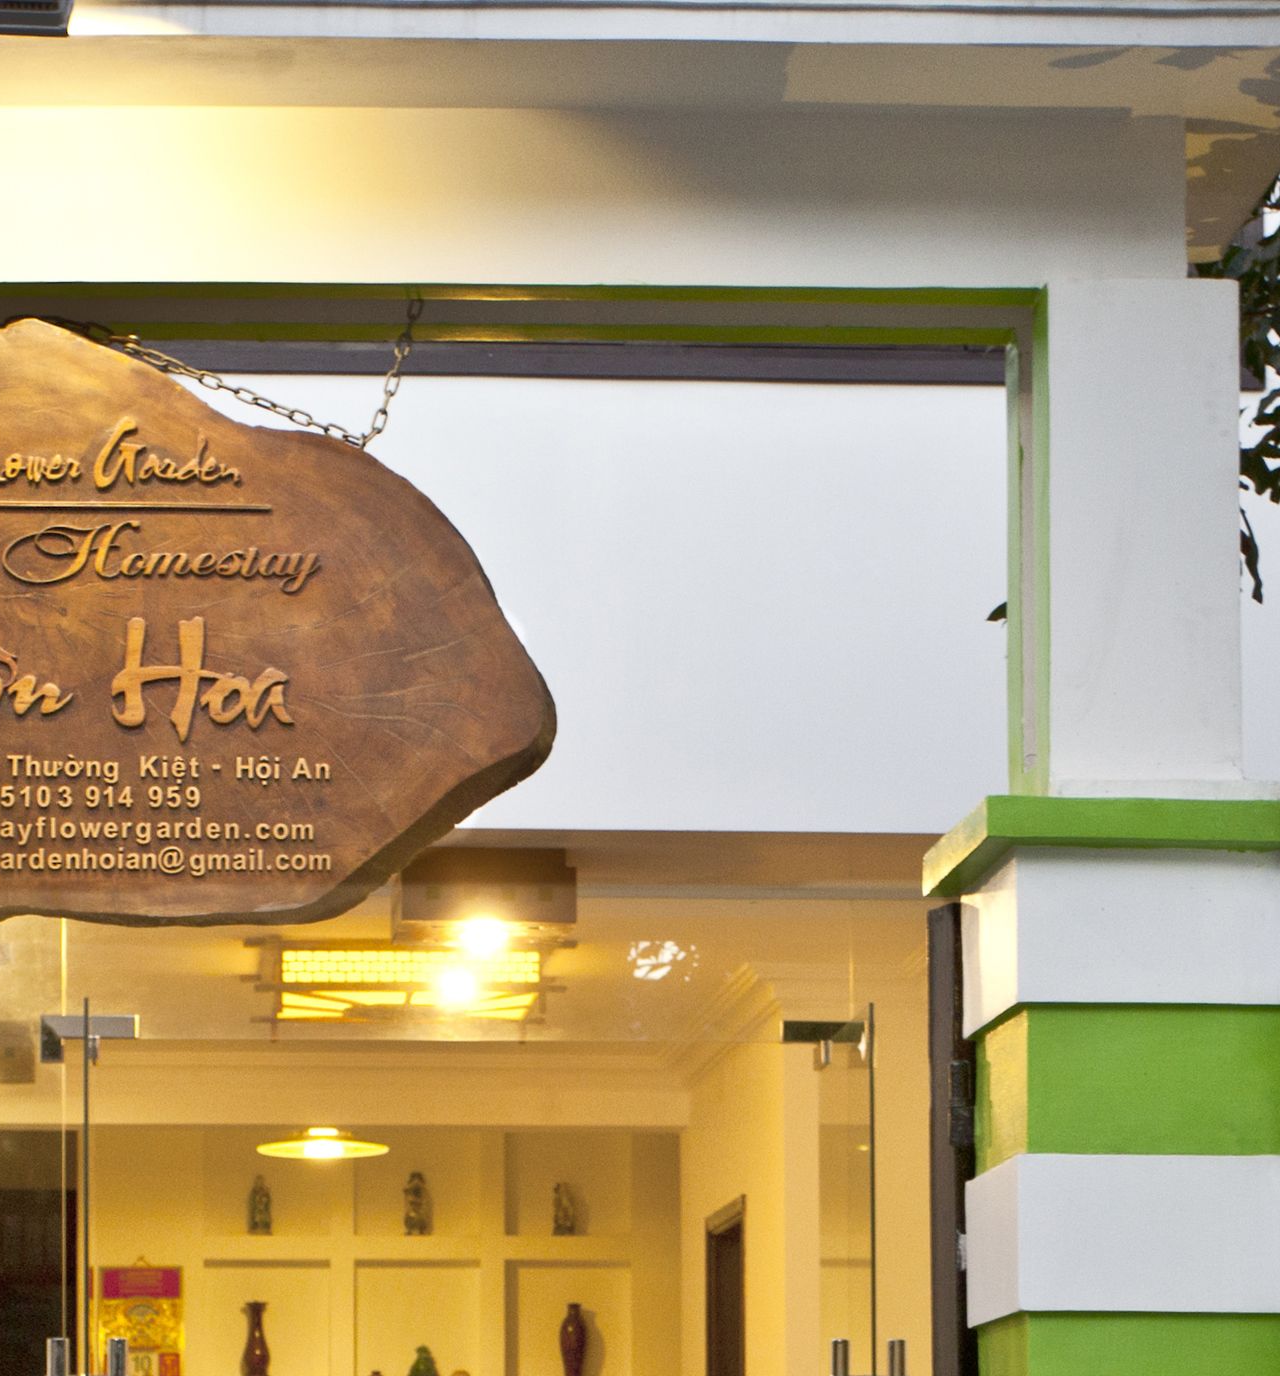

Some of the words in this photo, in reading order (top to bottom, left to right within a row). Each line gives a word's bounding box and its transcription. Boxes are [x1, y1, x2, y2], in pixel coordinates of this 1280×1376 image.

[93, 416, 242, 489] Garden
[2, 519, 322, 594] Homestay
[111, 615, 295, 744] Hoa
[6, 752, 120, 784] Thường
[139, 755, 201, 785] Kiệt
[235, 755, 281, 786] Hội
[291, 757, 332, 781] An
[85, 785, 135, 808] 914
[147, 786, 202, 809] 959
